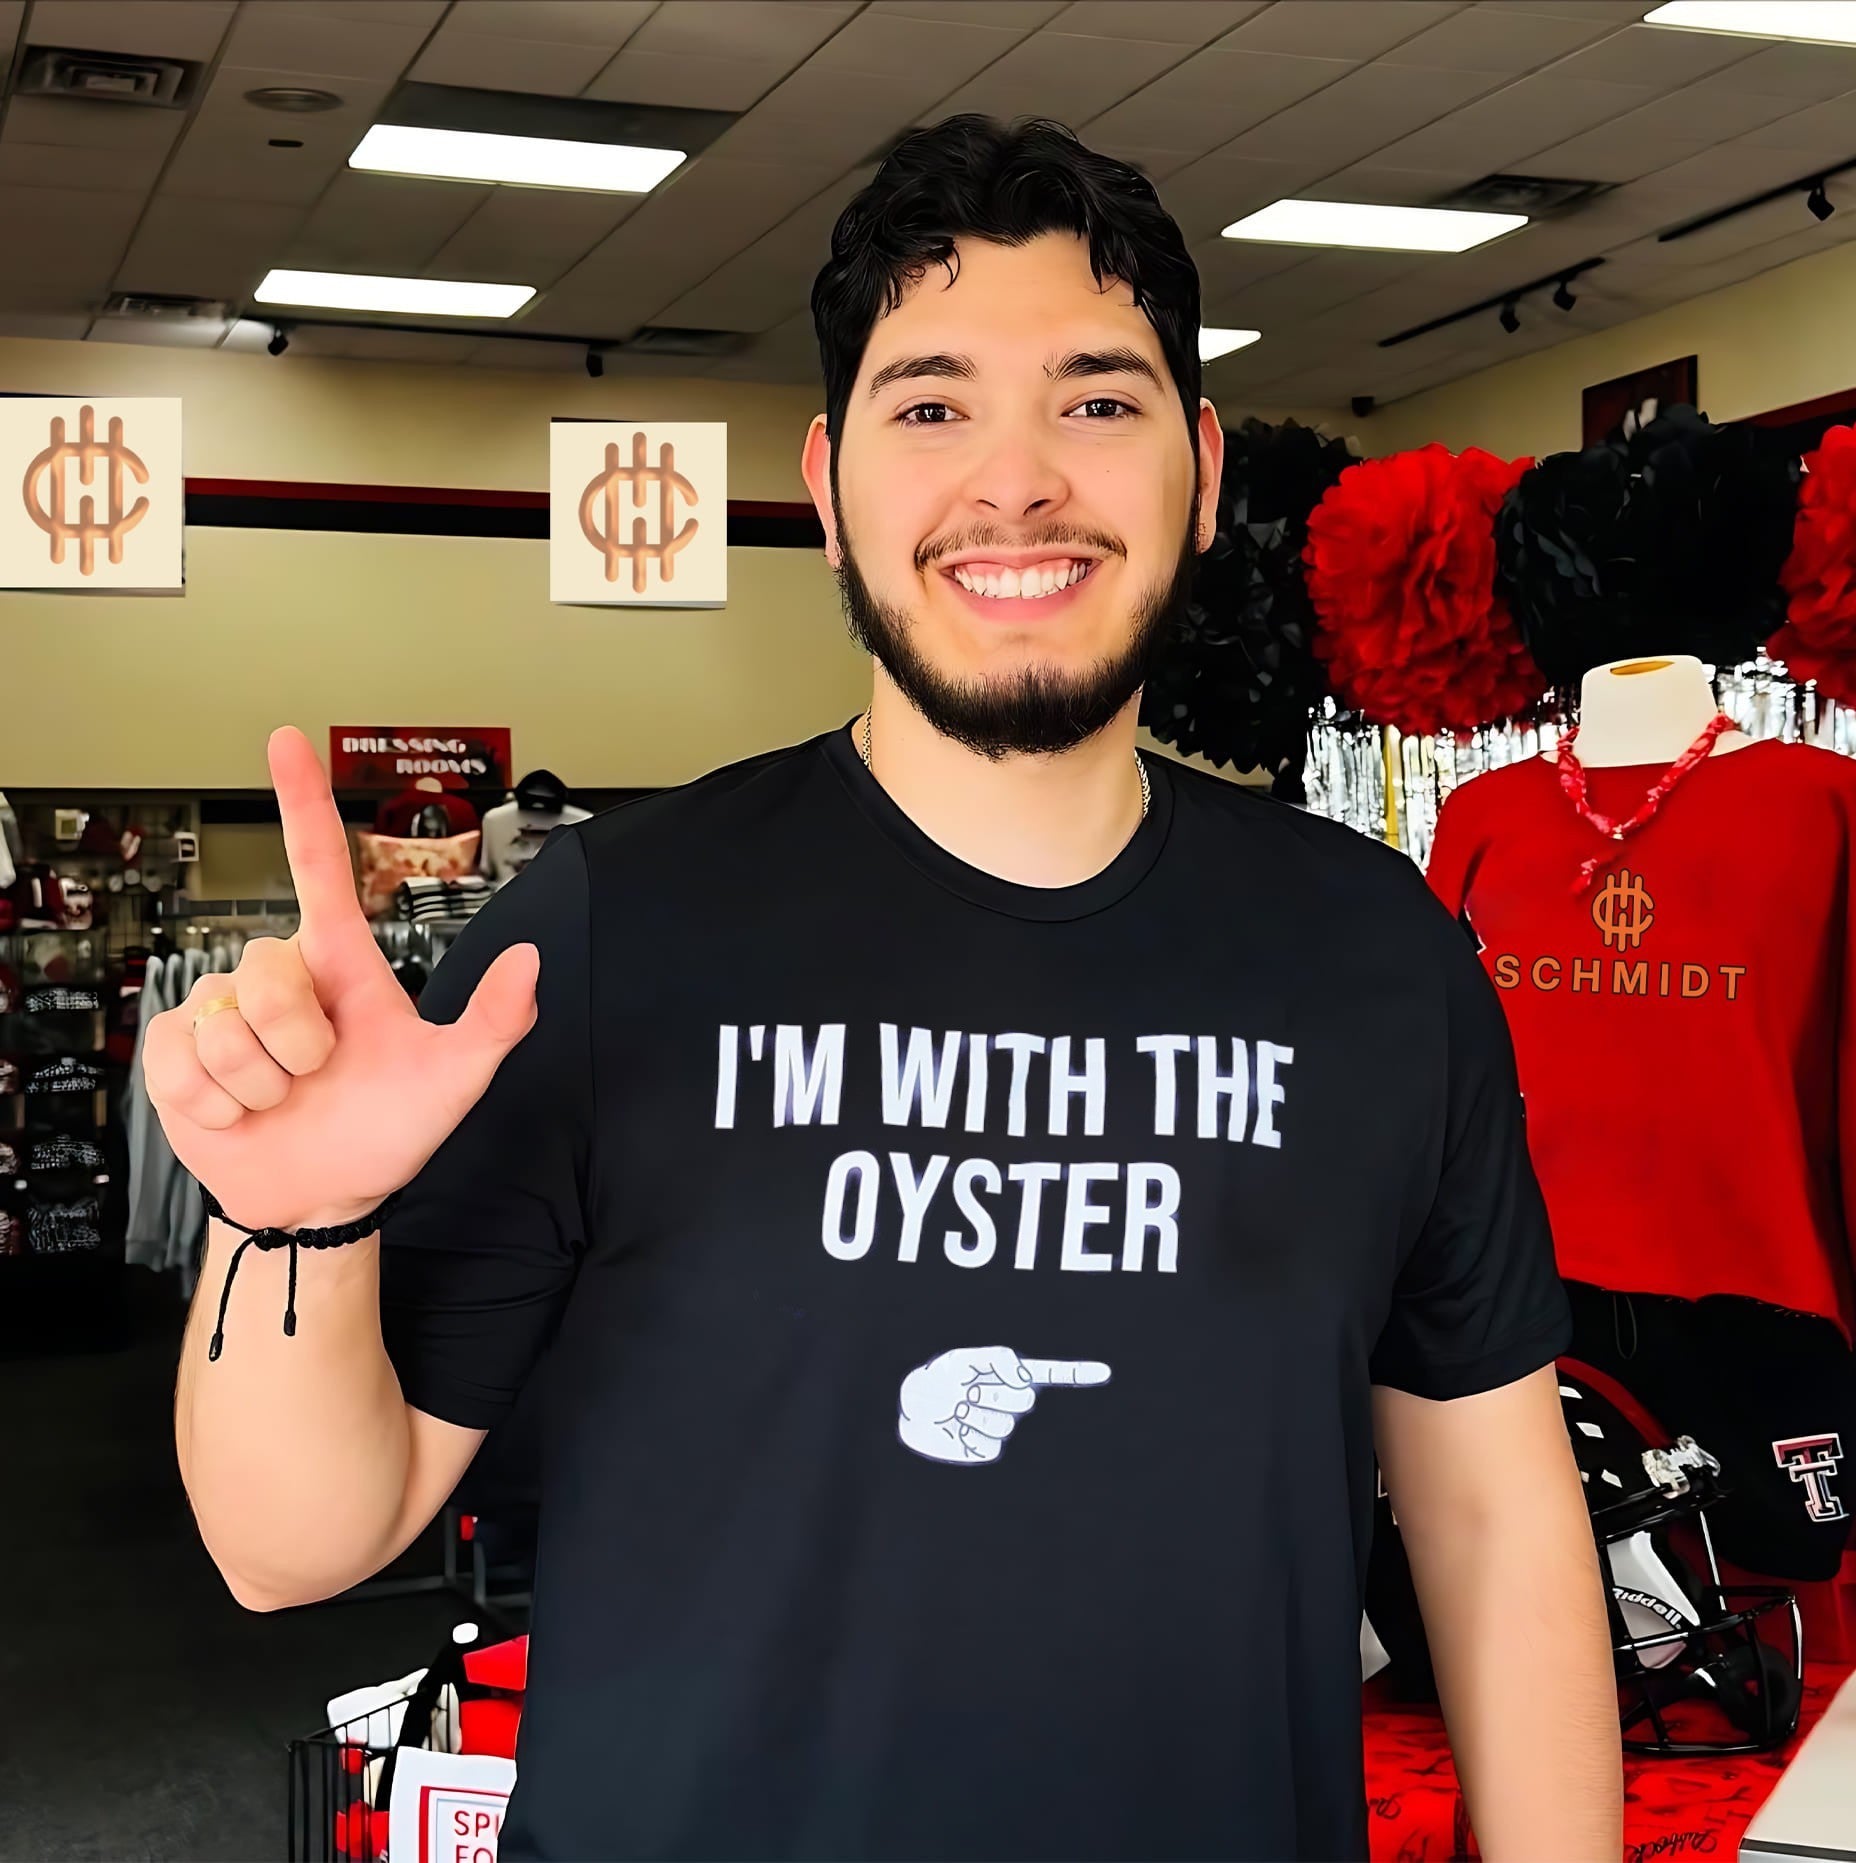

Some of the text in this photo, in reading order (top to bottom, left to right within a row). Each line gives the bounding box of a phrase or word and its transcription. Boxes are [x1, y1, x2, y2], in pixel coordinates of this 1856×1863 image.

[342, 737, 467, 754] DRESSING
[396, 758, 487, 775] ROOMS
[1494, 953, 1747, 1000] SCHMIDT
[714, 1022, 1295, 1149] I'M WITH THE
[821, 1150, 1182, 1273] OYSTER
